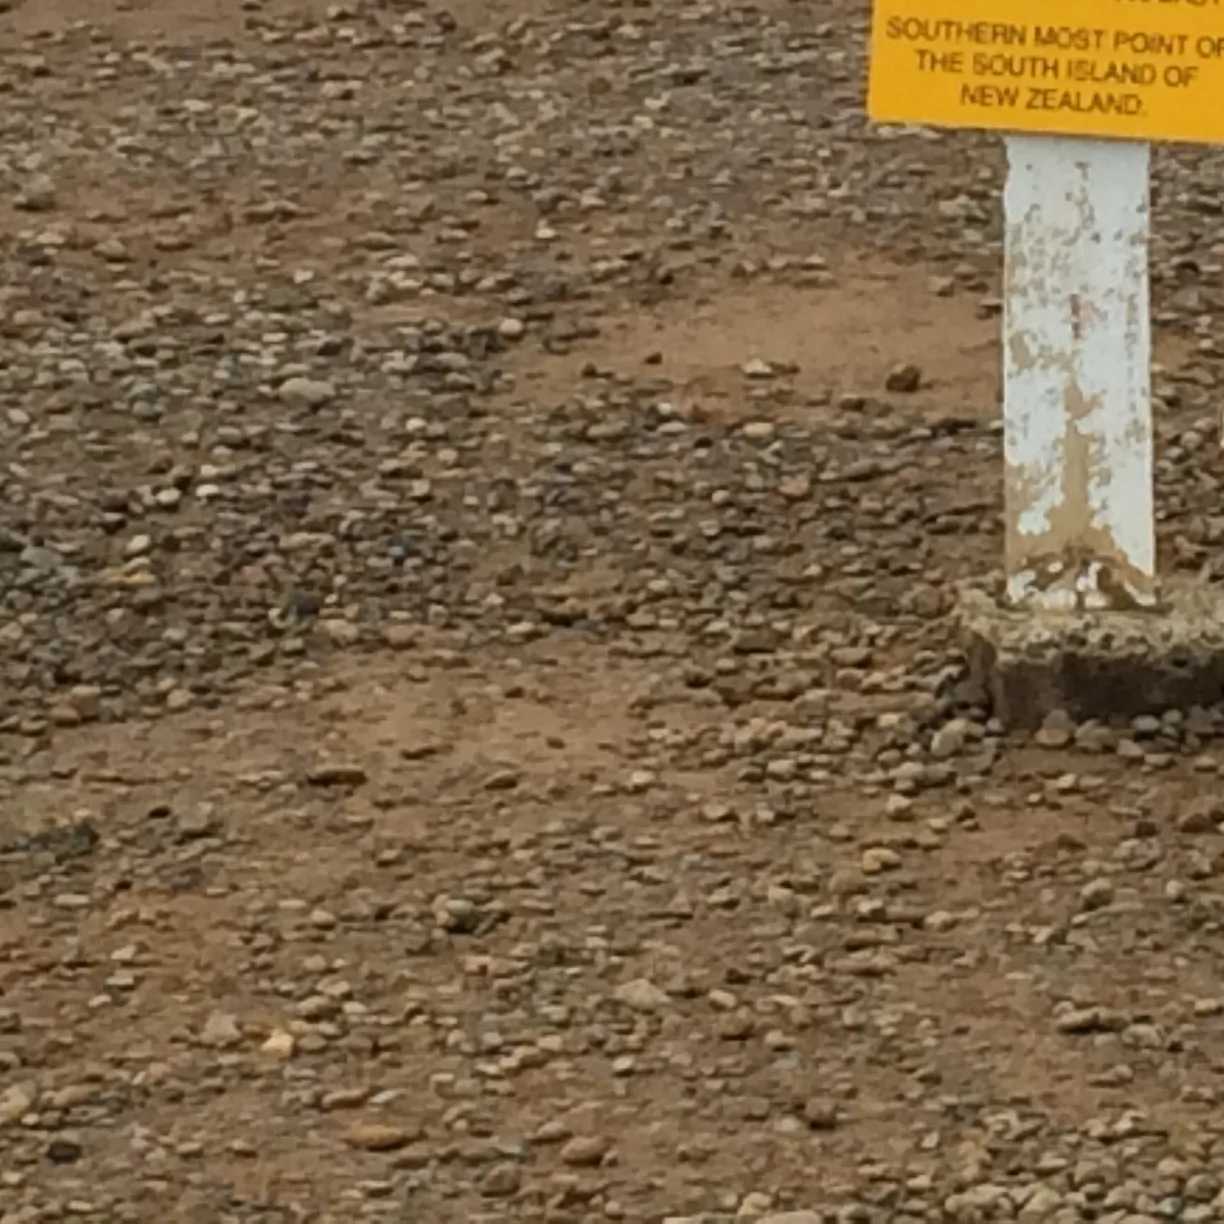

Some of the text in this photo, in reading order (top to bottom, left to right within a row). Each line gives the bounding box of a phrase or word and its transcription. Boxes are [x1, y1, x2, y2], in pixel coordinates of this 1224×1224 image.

[886, 17, 1026, 46] SOUTHERN
[1034, 26, 1104, 50] MOST
[1114, 31, 1187, 55] POINT
[915, 50, 1198, 86] THE SOUTH ISLAND OF
[961, 84, 1019, 108] NEW
